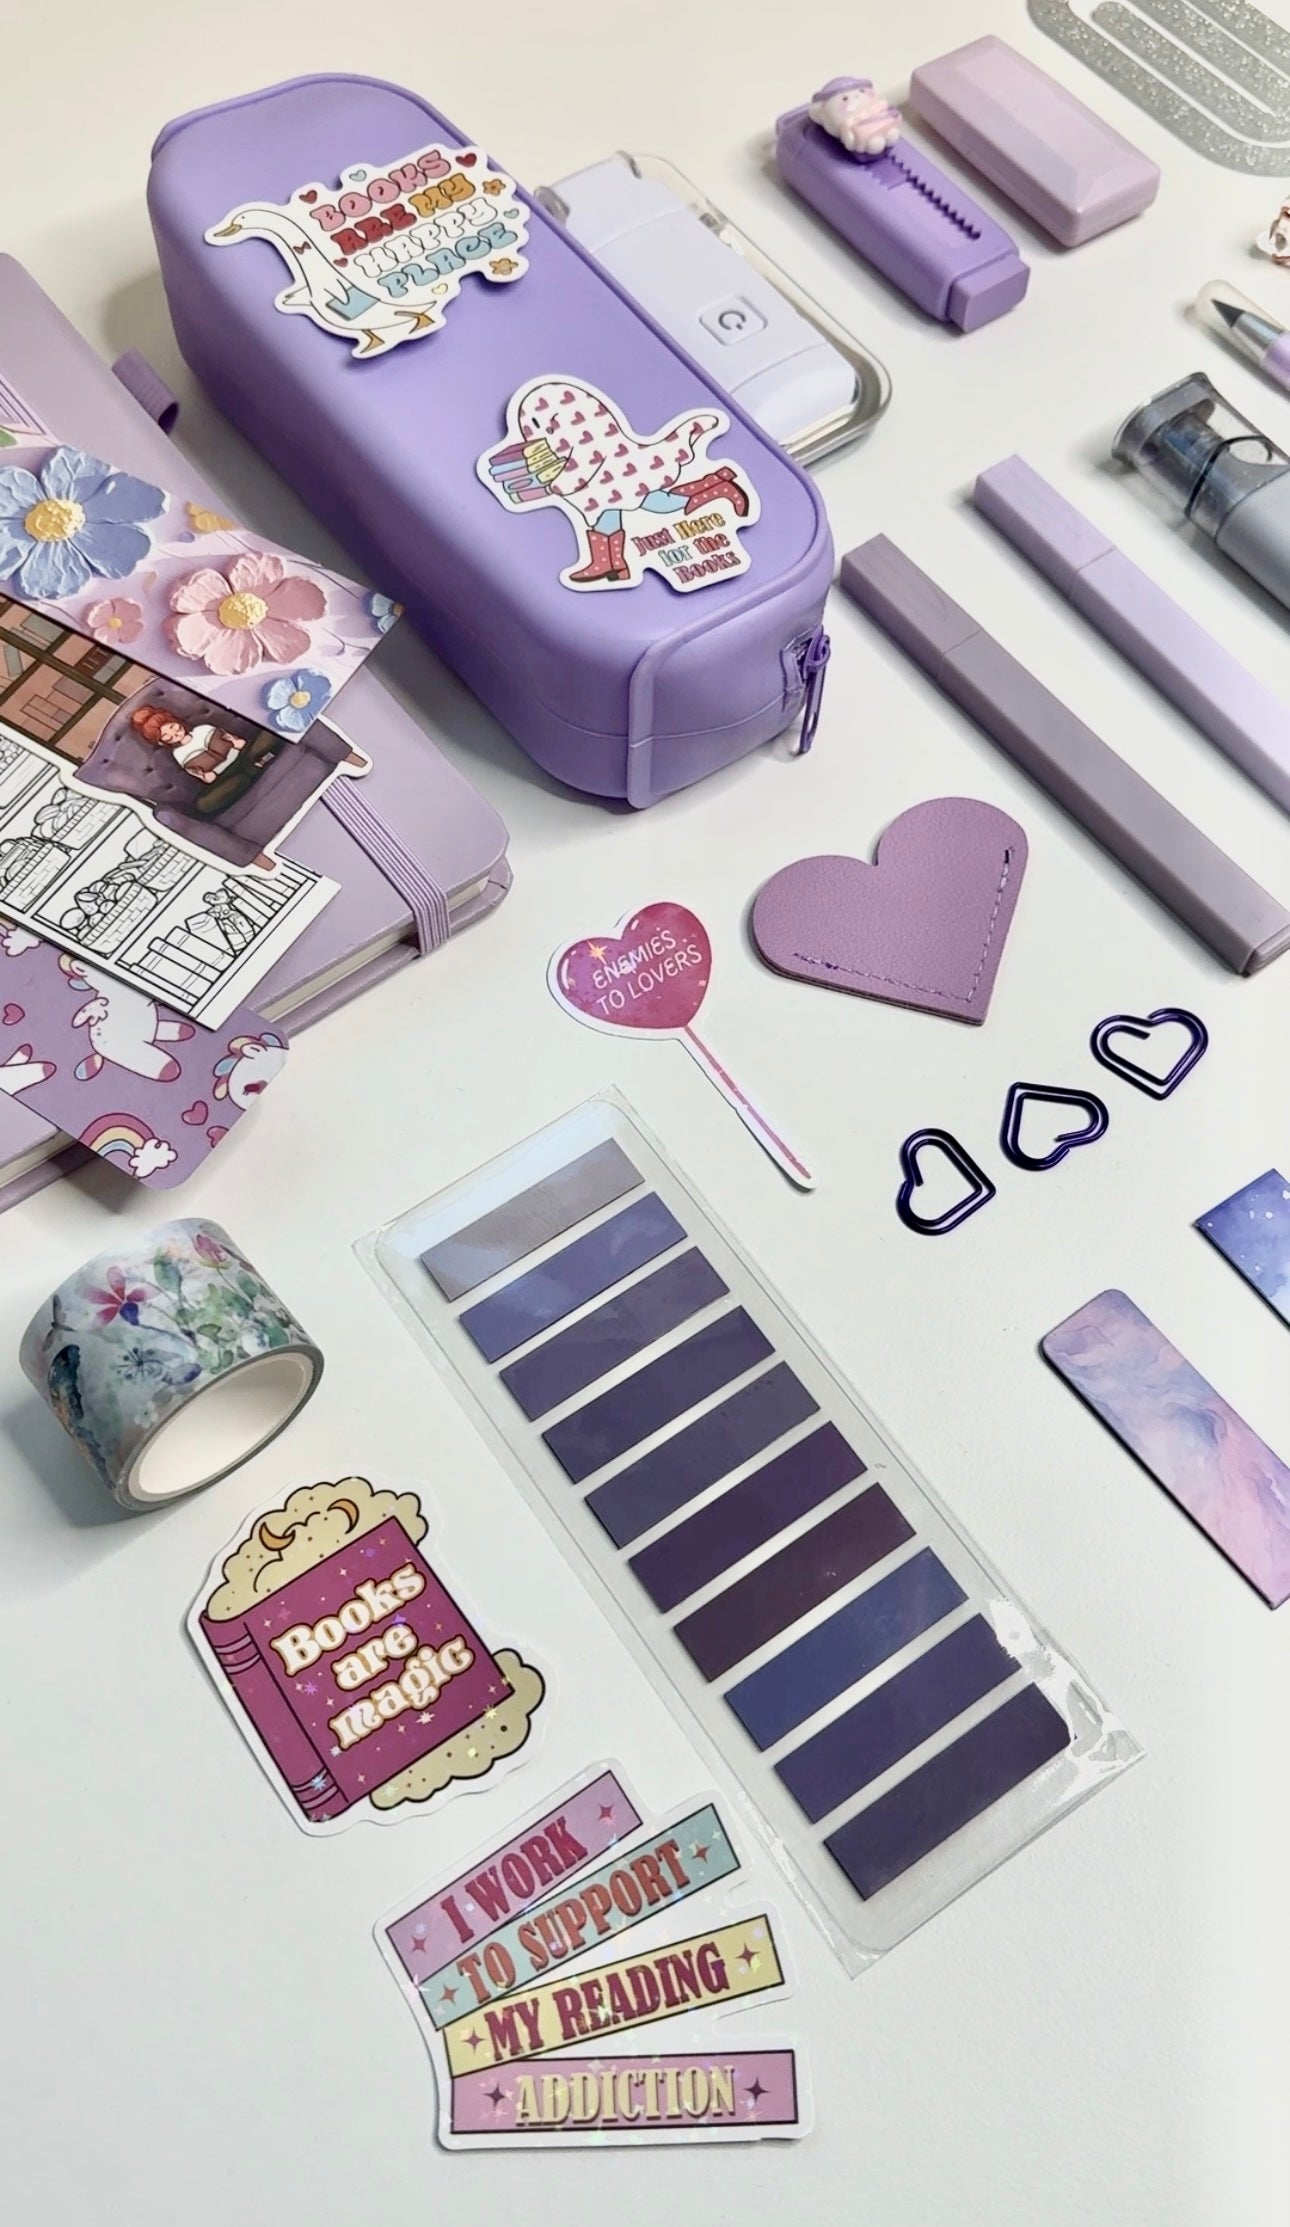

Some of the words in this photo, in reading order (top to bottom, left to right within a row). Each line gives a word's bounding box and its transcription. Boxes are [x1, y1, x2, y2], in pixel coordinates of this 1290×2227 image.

[310, 150, 451, 231] BOOKS
[331, 203, 417, 255] ARE
[408, 173, 475, 217] MY
[354, 197, 498, 278] HAPPY
[377, 222, 518, 298] PLACE
[631, 528, 676, 556] Just
[673, 513, 725, 540] Here
[658, 545, 693, 567] for
[693, 533, 731, 555] the
[673, 551, 741, 584] Books
[593, 930, 676, 988] ENEMIES
[596, 990, 625, 1014] TO
[627, 944, 702, 999] LOVERS
[270, 1562, 426, 1678] Books
[331, 1623, 418, 1691] are
[328, 1635, 475, 1751] magic
[440, 1895, 474, 1943] I
[465, 1815, 588, 1922] WORK
[457, 1941, 516, 2005] TO
[517, 1839, 691, 1972] SUPPORT
[484, 1997, 545, 2062] MY
[552, 1941, 730, 2040] READING
[515, 2065, 736, 2127] ADDICTION
